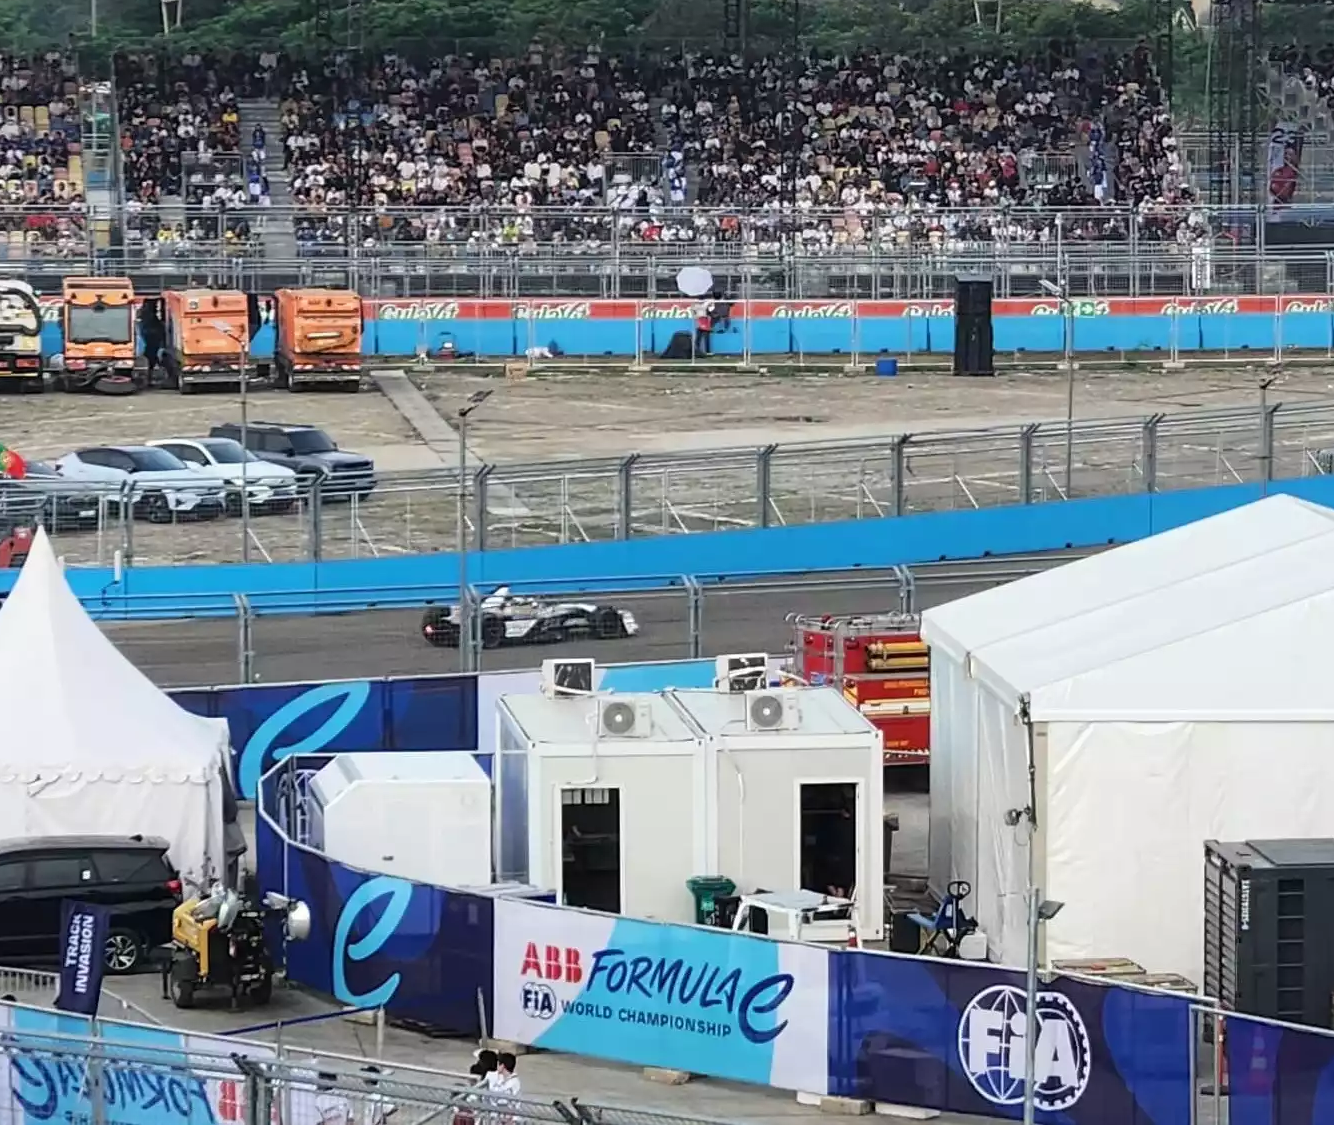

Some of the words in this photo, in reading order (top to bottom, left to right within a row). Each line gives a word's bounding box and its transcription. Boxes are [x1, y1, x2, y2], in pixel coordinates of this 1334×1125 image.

[65, 913, 82, 967] TRACK
[75, 915, 95, 993] INVASION
[521, 941, 583, 984] ABB
[587, 949, 742, 1014] FORMULA
[561, 999, 613, 1020] WORLD
[619, 1008, 732, 1038] CHAMPIONSHIP
